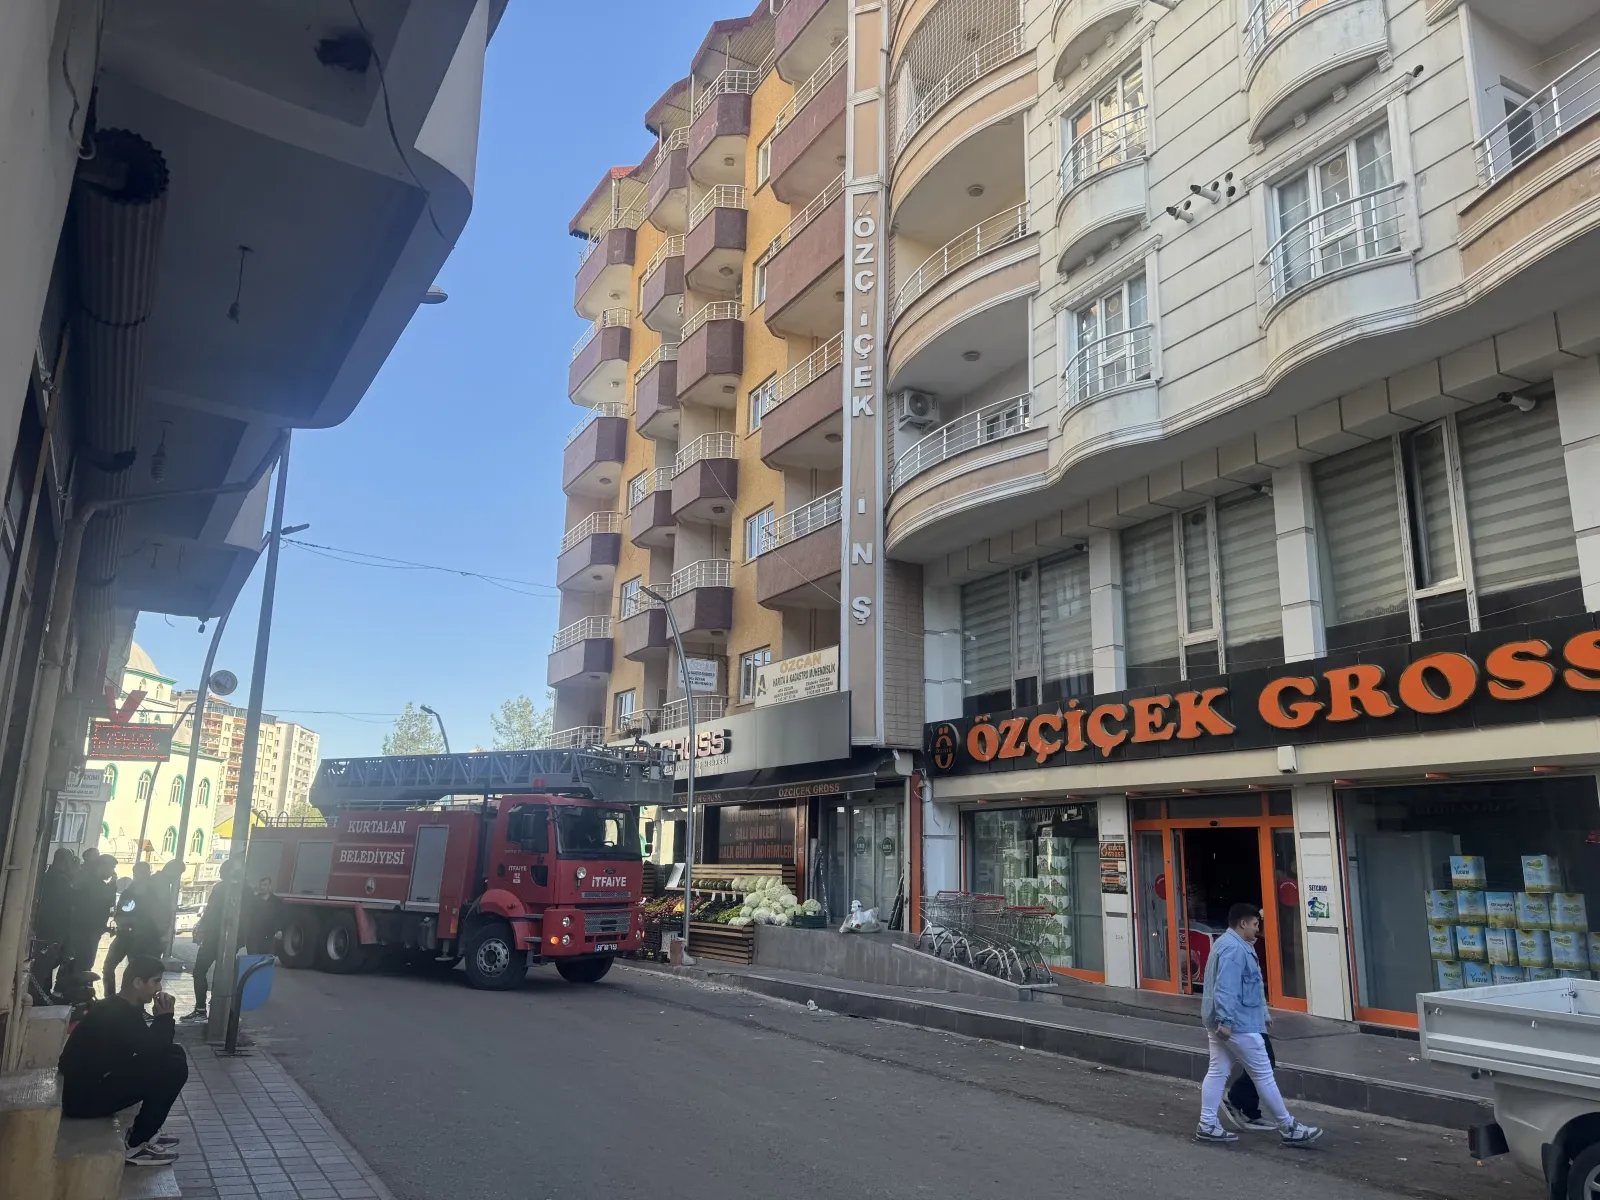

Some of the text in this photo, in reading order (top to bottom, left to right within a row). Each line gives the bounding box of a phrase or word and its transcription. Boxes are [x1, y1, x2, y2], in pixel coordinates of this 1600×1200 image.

[780, 652, 822, 674] ÖZCAN
[967, 630, 1600, 764] ÖZÇİÇEK GROSS
[812, 783, 840, 794] GROSS
[347, 820, 407, 834] KURTALAN
[339, 848, 406, 865] BELEDİYESİ
